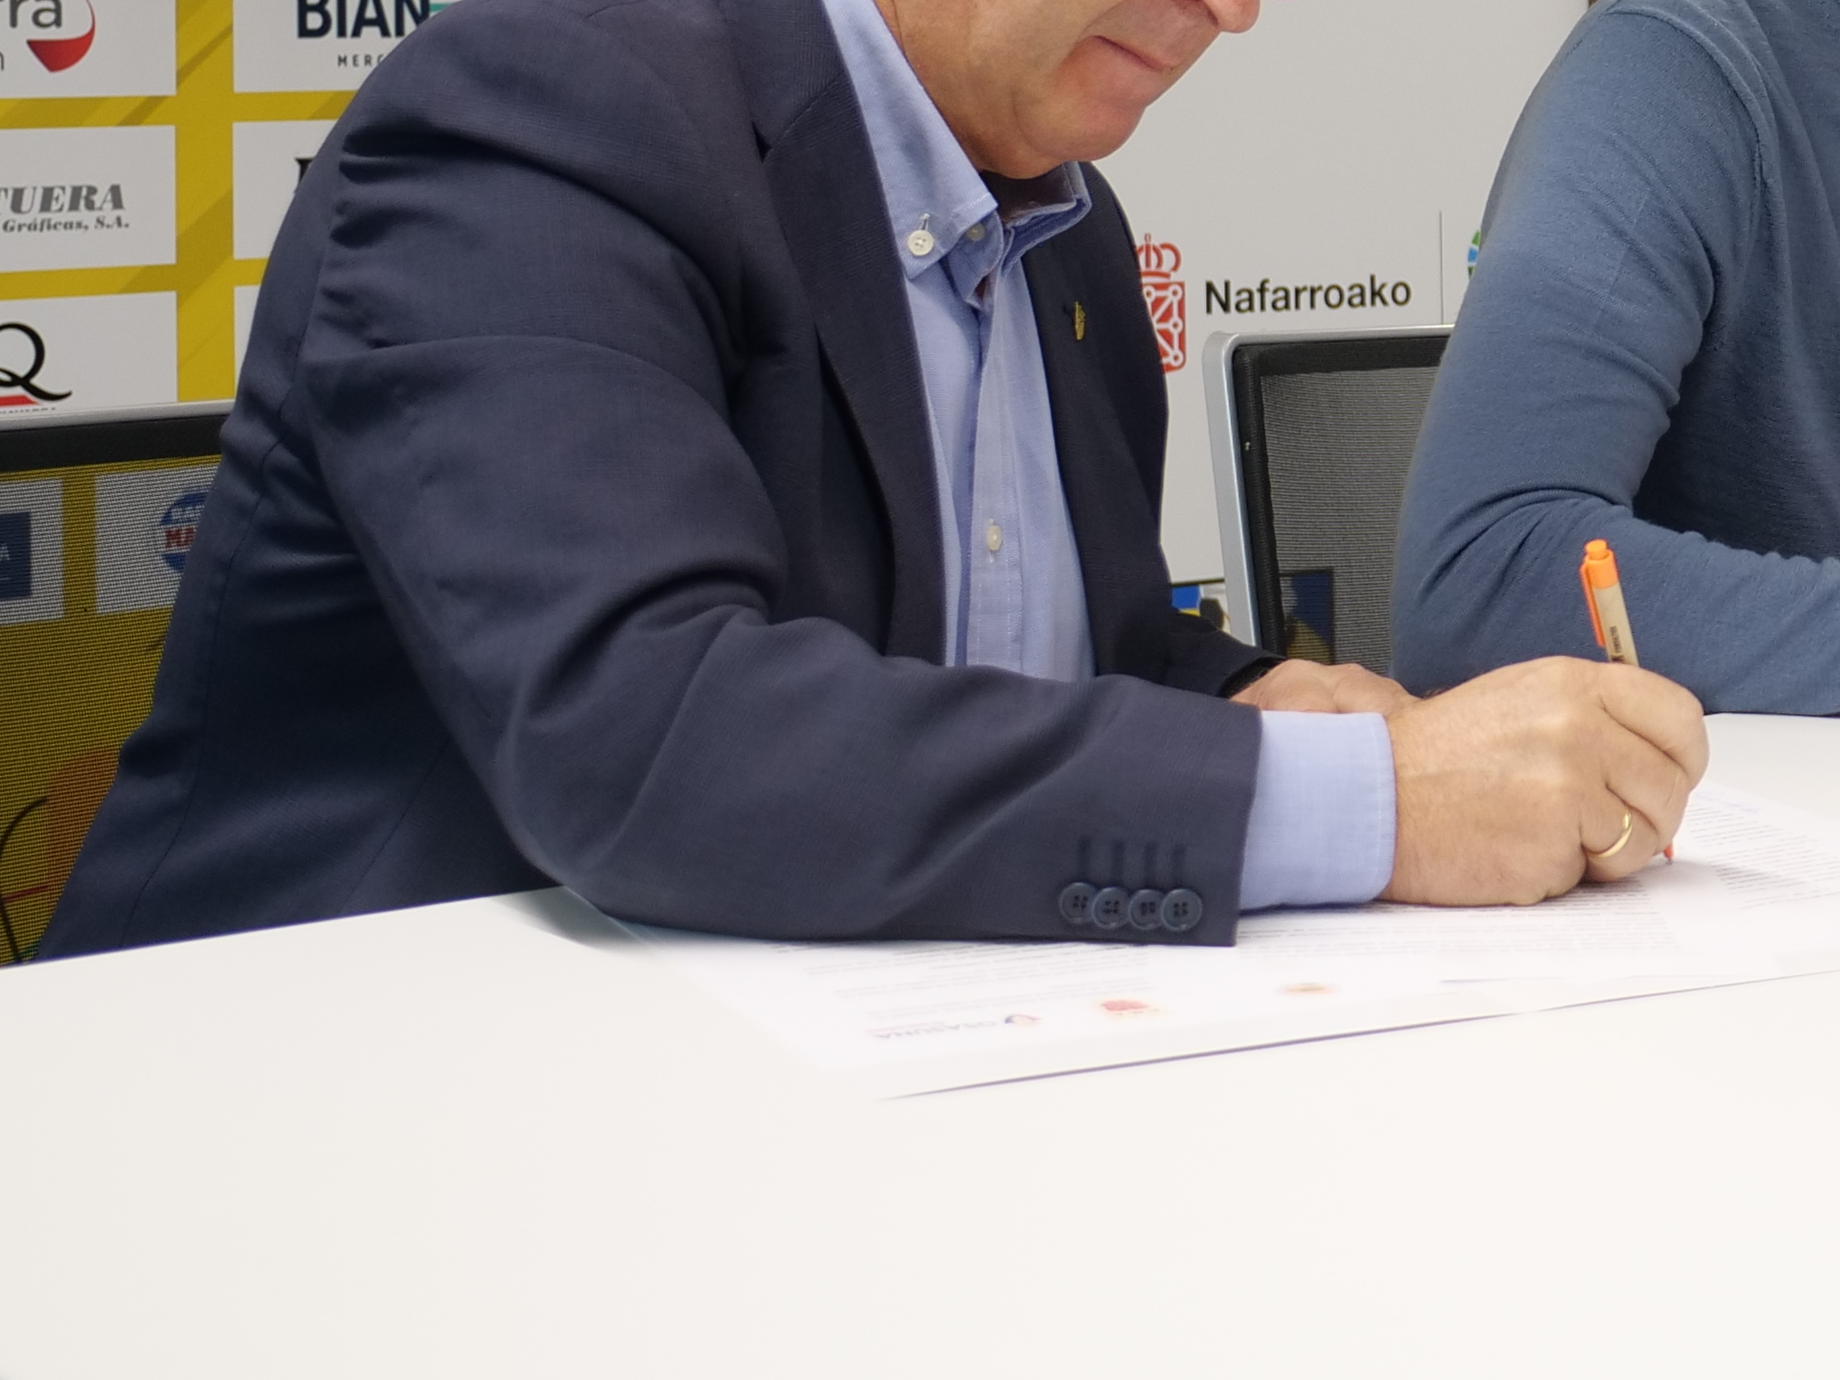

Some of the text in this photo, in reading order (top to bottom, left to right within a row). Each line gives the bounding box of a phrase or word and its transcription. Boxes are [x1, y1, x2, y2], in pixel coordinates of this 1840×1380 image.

[2, 215, 130, 233] Gráficas, S.A.
[1205, 274, 1412, 315] Nafarroako
